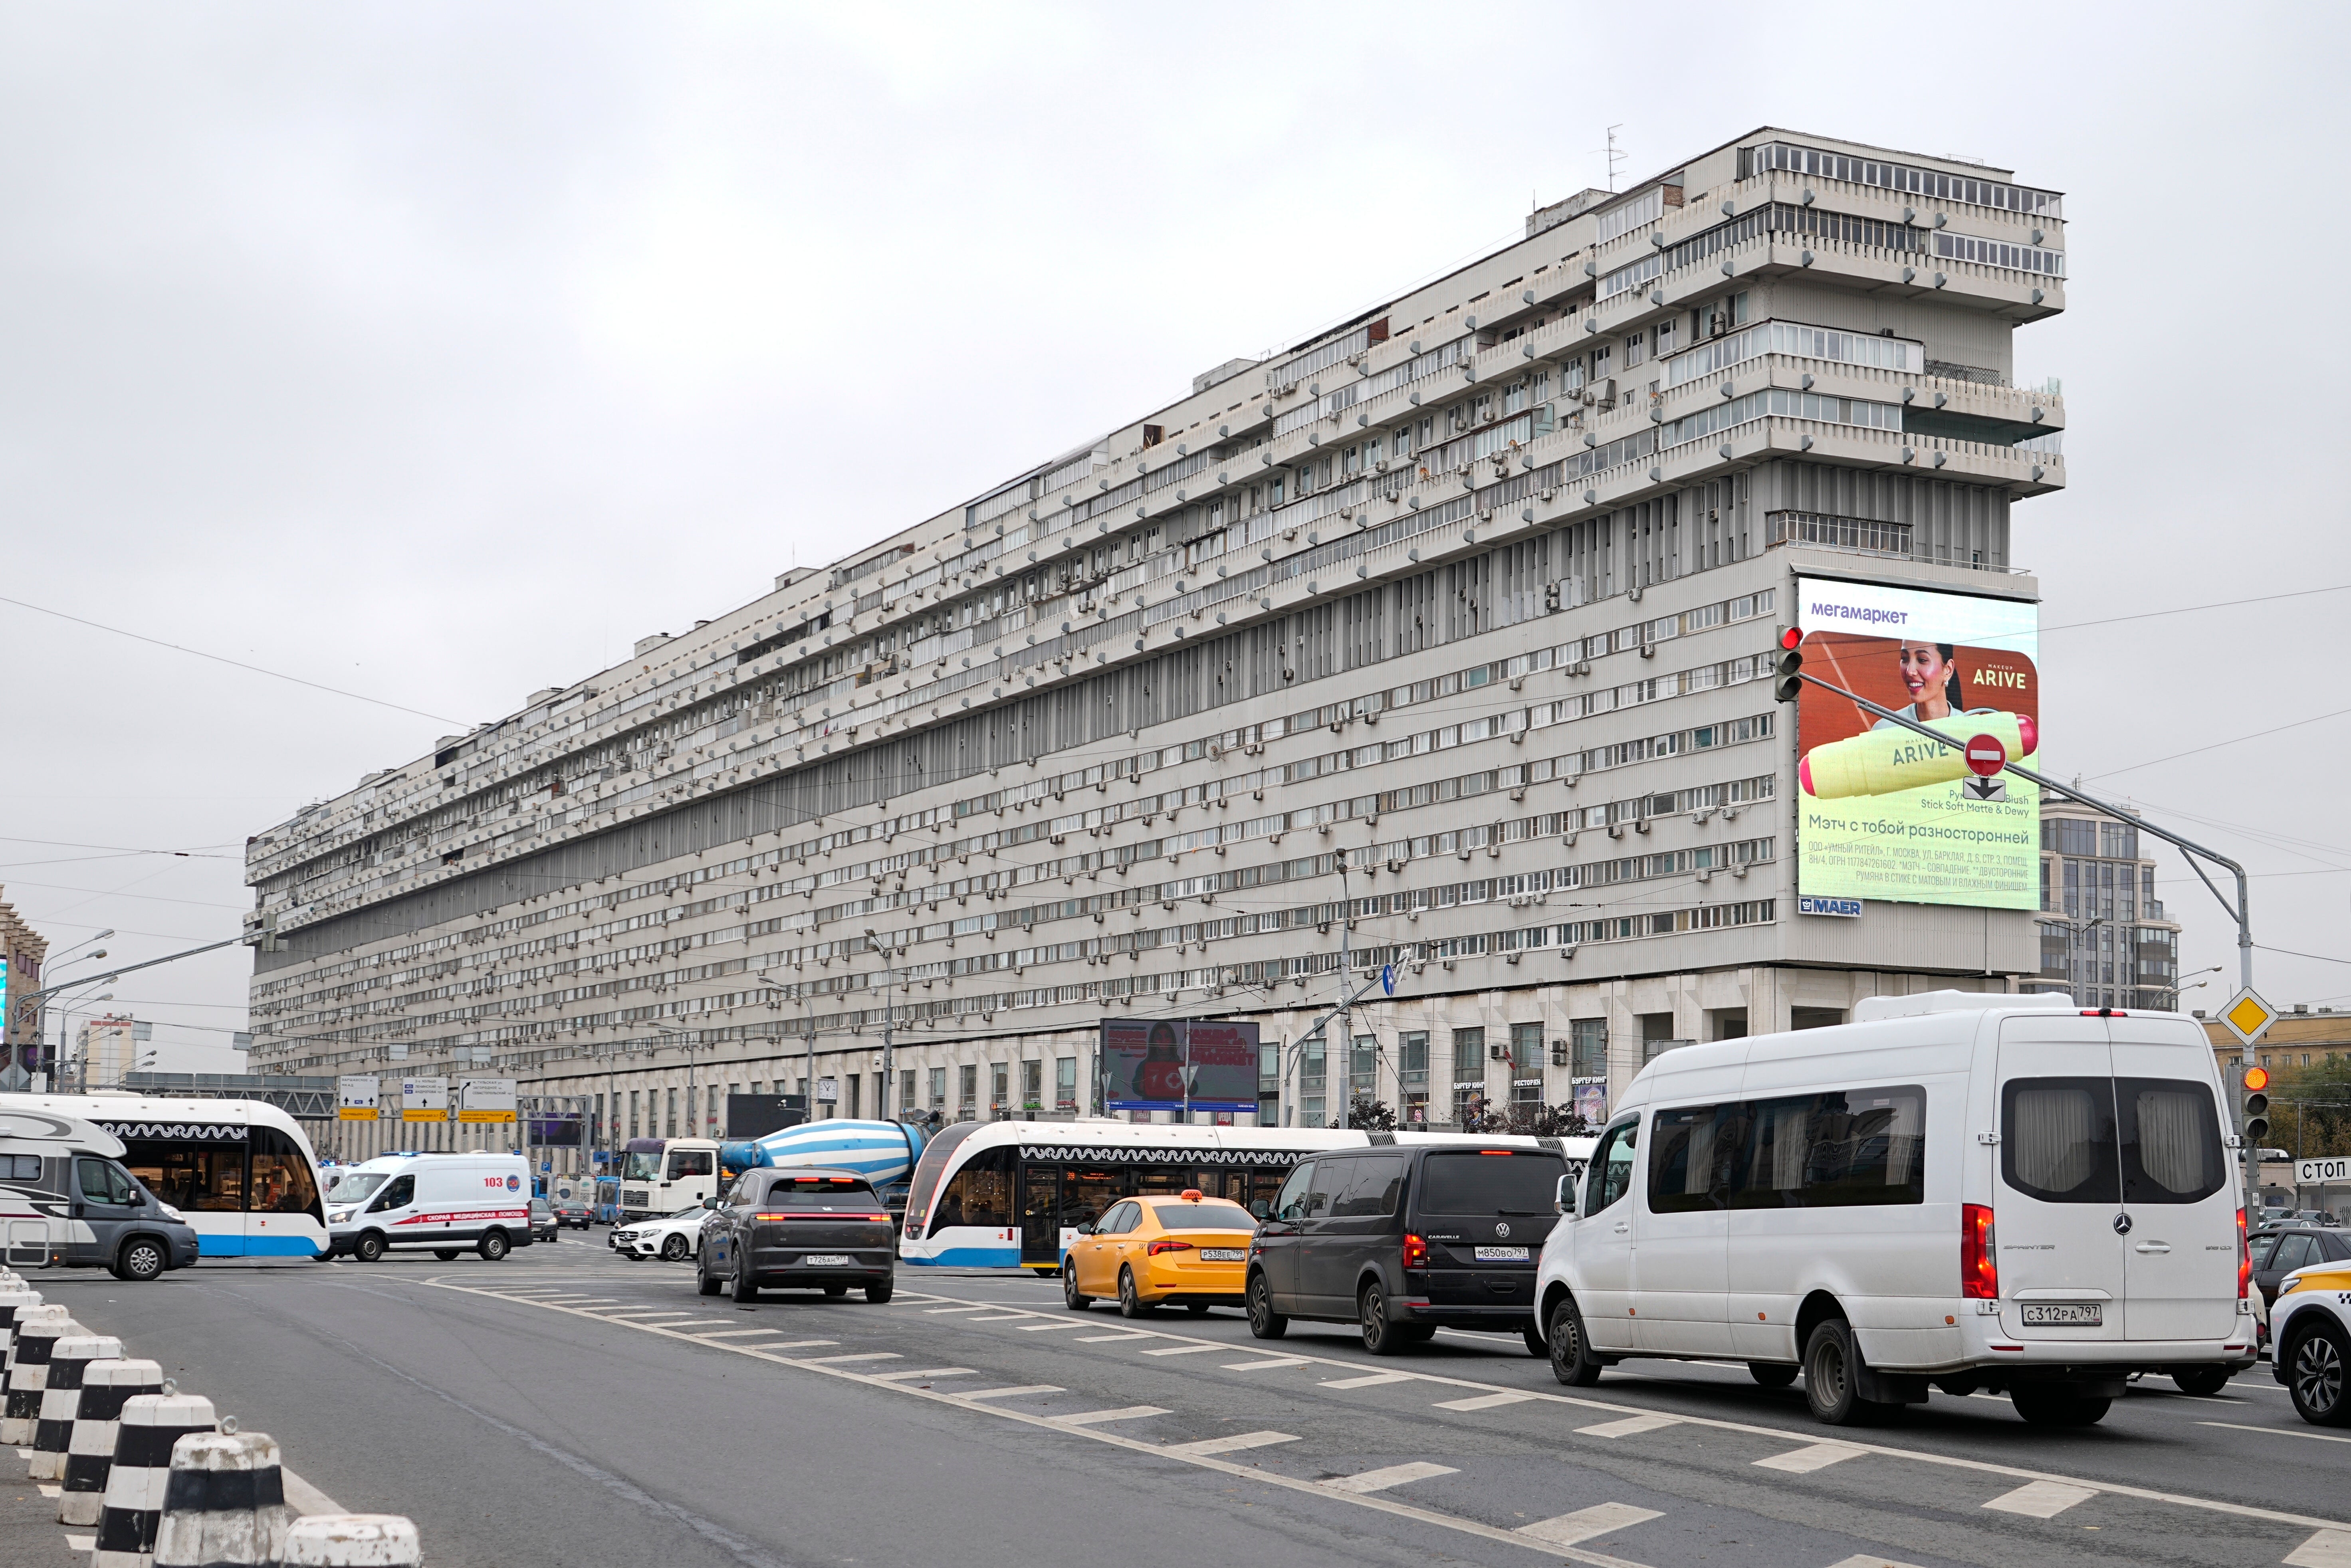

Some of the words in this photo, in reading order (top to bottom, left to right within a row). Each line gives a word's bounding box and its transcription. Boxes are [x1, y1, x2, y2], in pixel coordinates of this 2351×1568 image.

[1811, 603, 1908, 624] мегамаркет
[1973, 669, 2026, 689] ARIVE
[1893, 741, 1949, 766] ARIVE
[1921, 799, 1943, 809] Stick
[1946, 801, 1964, 811] Soft
[1966, 803, 1993, 813] Matte
[1996, 805, 2002, 814] &
[2005, 806, 2029, 818] Dewy
[2006, 794, 2029, 804] Blush
[1809, 814, 1845, 830] Мэтч
[1850, 821, 1858, 831] с
[1862, 820, 1904, 835] тобой
[1909, 826, 2029, 844] разносторонней
[1809, 841, 1822, 851] ООО
[1825, 842, 1853, 853] «УМНЫЙ
[1855, 844, 1885, 856] РИТЕЙЛ»,
[1887, 847, 1891, 856] Г.
[1893, 848, 1921, 859] МОСКВА,
[1923, 849, 1933, 860] УЛ.
[1935, 851, 1965, 863] БАРКЛАЯ,
[1967, 853, 1974, 863] Д.
[1982, 854, 1994, 864] СТР.
[1829, 856, 1845, 866] ОГРН
[1927, 862, 1971, 875] СОВПАДЕНИЕ.
[1856, 871, 1883, 882] РУМЯНА
[1885, 873, 1889, 882] В
[1891, 873, 1911, 883] СТИКЕ
[1913, 875, 1917, 884] С
[1919, 875, 1951, 886] МАТОВЫМ
[1953, 877, 1957, 886] И
[1959, 878, 1992, 889] ВЛАЖНЫМ
[1994, 880, 2029, 891] ФИНИШЕМ.
[1814, 899, 1860, 915] MAER
[1218, 1112, 1231, 1122] АРЕНДА
[2303, 1161, 2345, 1179] СТОП
[484, 1178, 502, 1187] 103
[2078, 1307, 2097, 1317] 797
